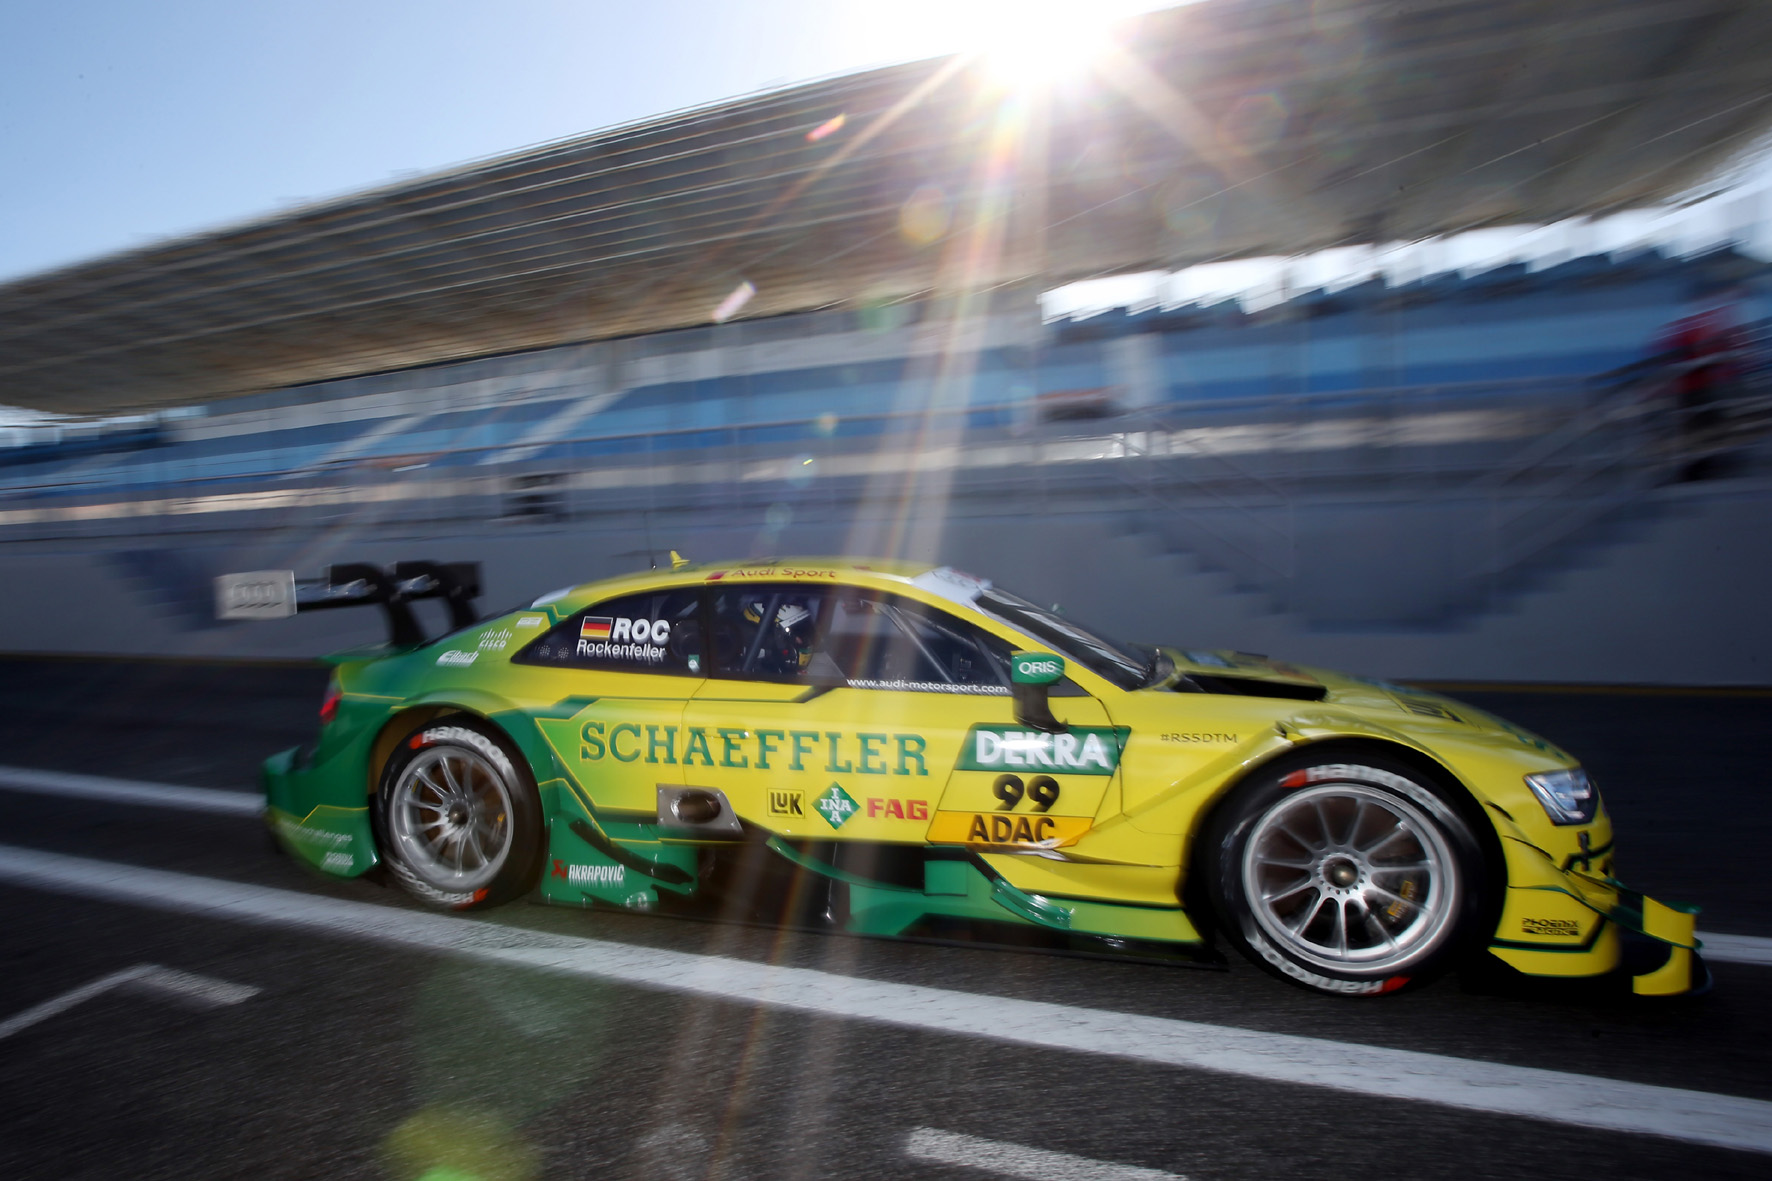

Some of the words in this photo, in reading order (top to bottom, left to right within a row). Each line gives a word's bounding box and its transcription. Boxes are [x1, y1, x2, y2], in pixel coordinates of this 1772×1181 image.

[731, 567, 776, 577] Audi
[781, 567, 837, 579] Sport
[612, 617, 671, 643] ROC
[576, 639, 666, 659] Rockenfeller
[1018, 660, 1060, 676] ORIS
[846, 678, 1008, 694] www.audi-motorsport.com
[580, 720, 930, 776] SCHAEFFLER
[975, 730, 1109, 767] DEKRA
[992, 773, 1060, 813] 99
[866, 797, 928, 821] FAG
[967, 813, 1055, 846] ADAC
